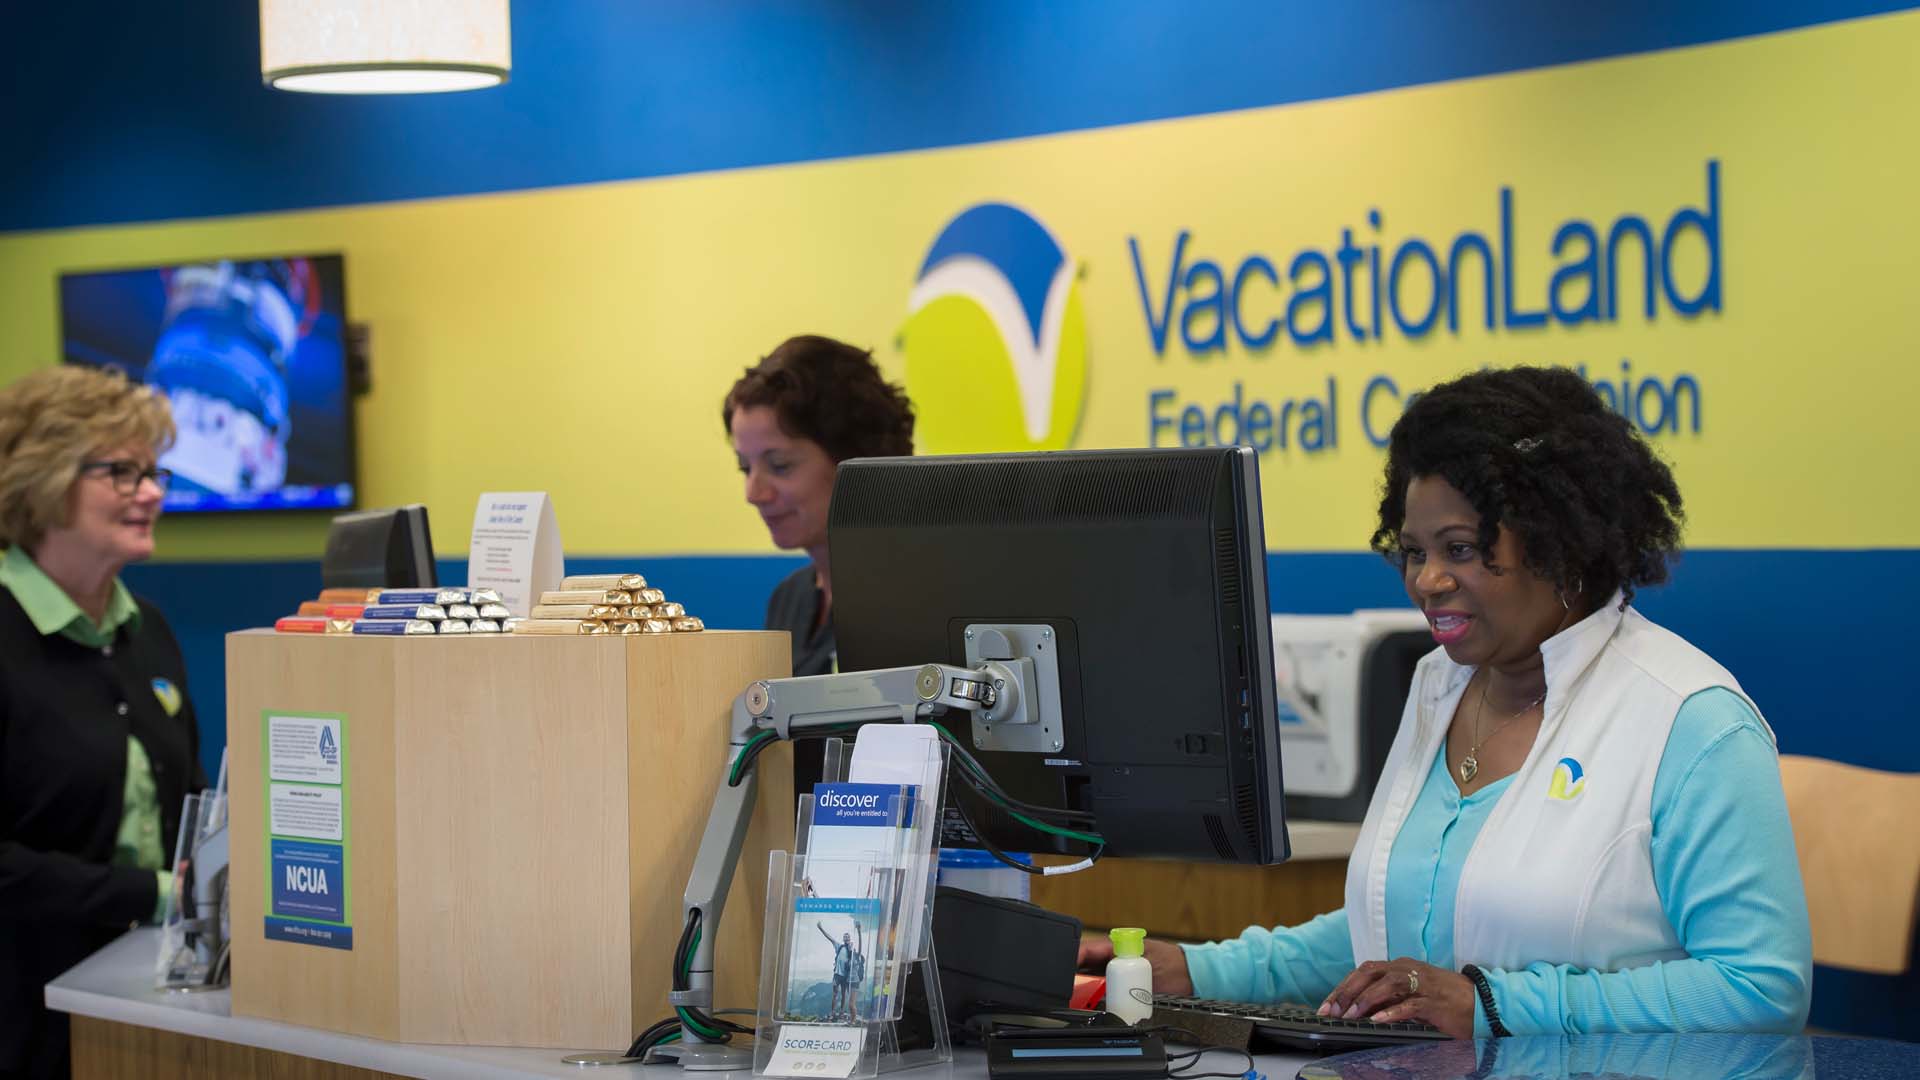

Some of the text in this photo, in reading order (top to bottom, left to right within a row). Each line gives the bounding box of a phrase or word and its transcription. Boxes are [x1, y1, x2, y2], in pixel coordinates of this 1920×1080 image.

[1128, 160, 1721, 356] VacationLand
[1148, 375, 1338, 454] Federal
[820, 790, 879, 807] discover
[844, 809, 860, 818] you're
[286, 865, 328, 895] NCUA
[784, 1039, 851, 1051] SCORECARD
